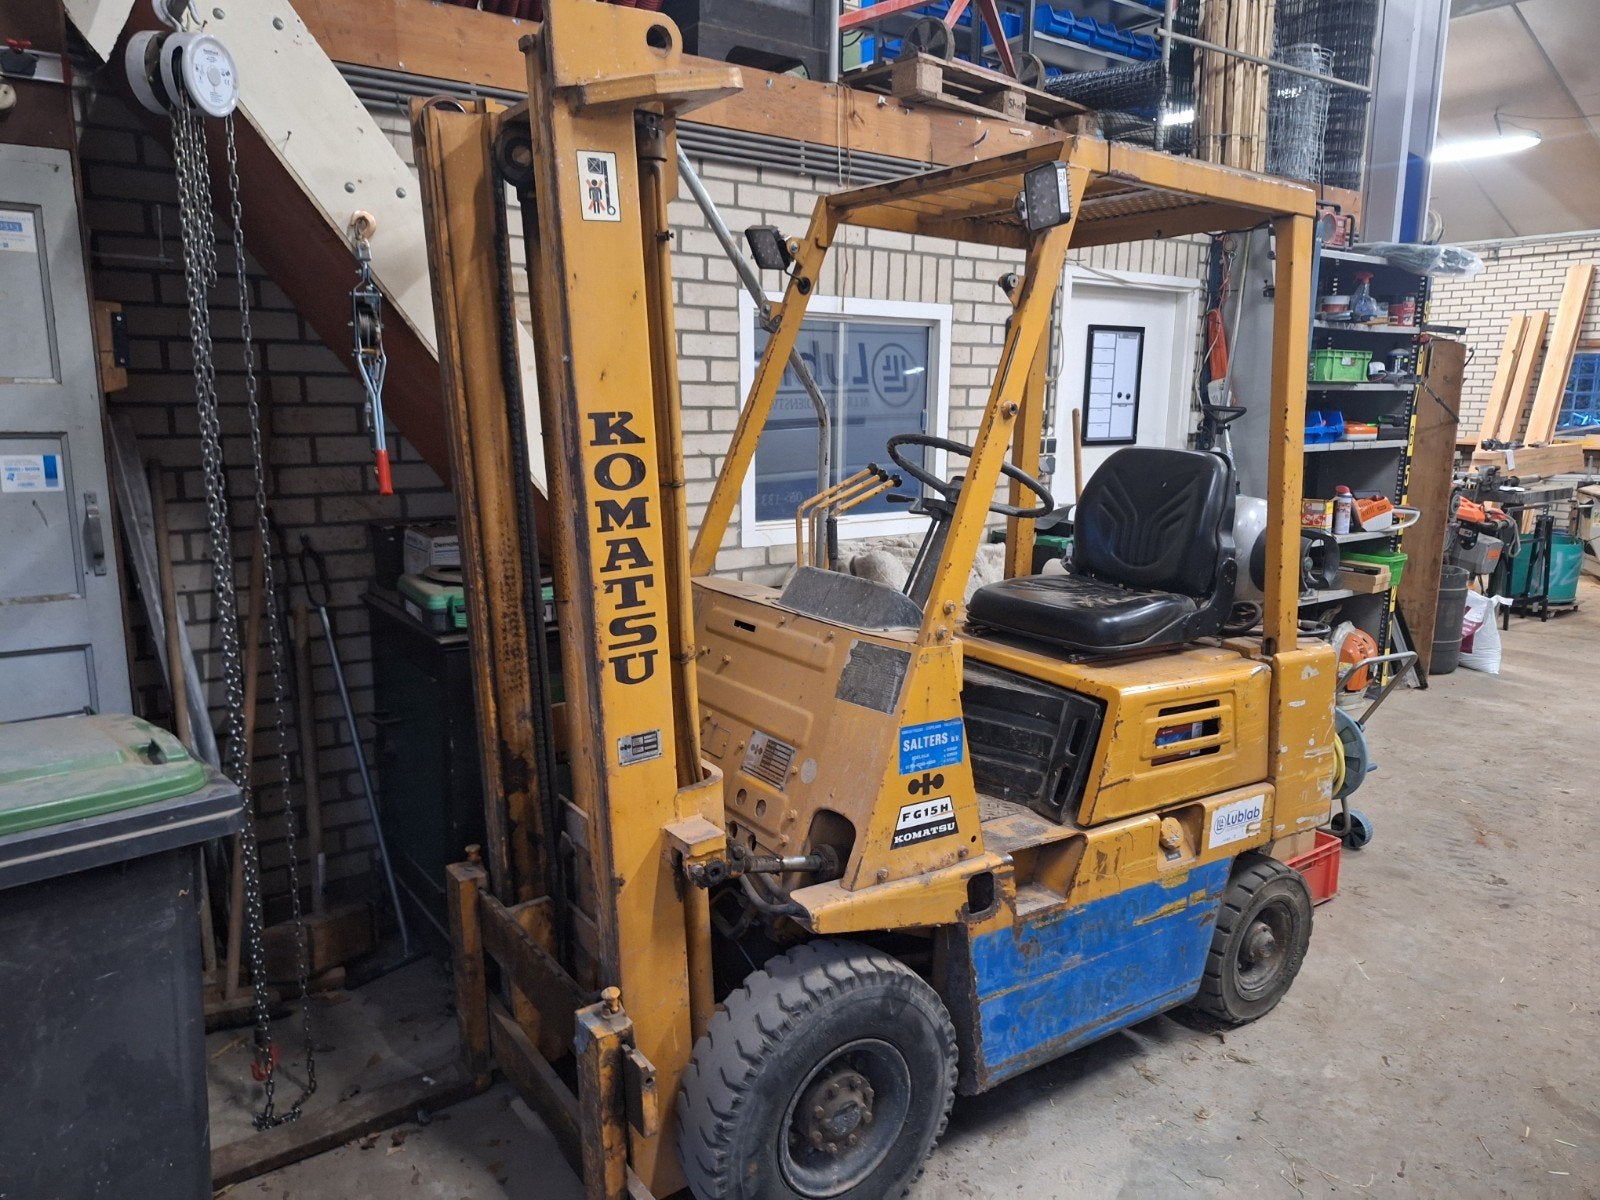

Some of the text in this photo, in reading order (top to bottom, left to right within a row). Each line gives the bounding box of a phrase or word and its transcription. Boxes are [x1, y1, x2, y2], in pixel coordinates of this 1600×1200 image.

[587, 411, 658, 685] KOMATSU
[903, 732, 948, 752] SALTERS
[902, 803, 949, 822] FG15H
[1227, 806, 1260, 826] Lublab
[893, 821, 956, 844] KOMATSU
